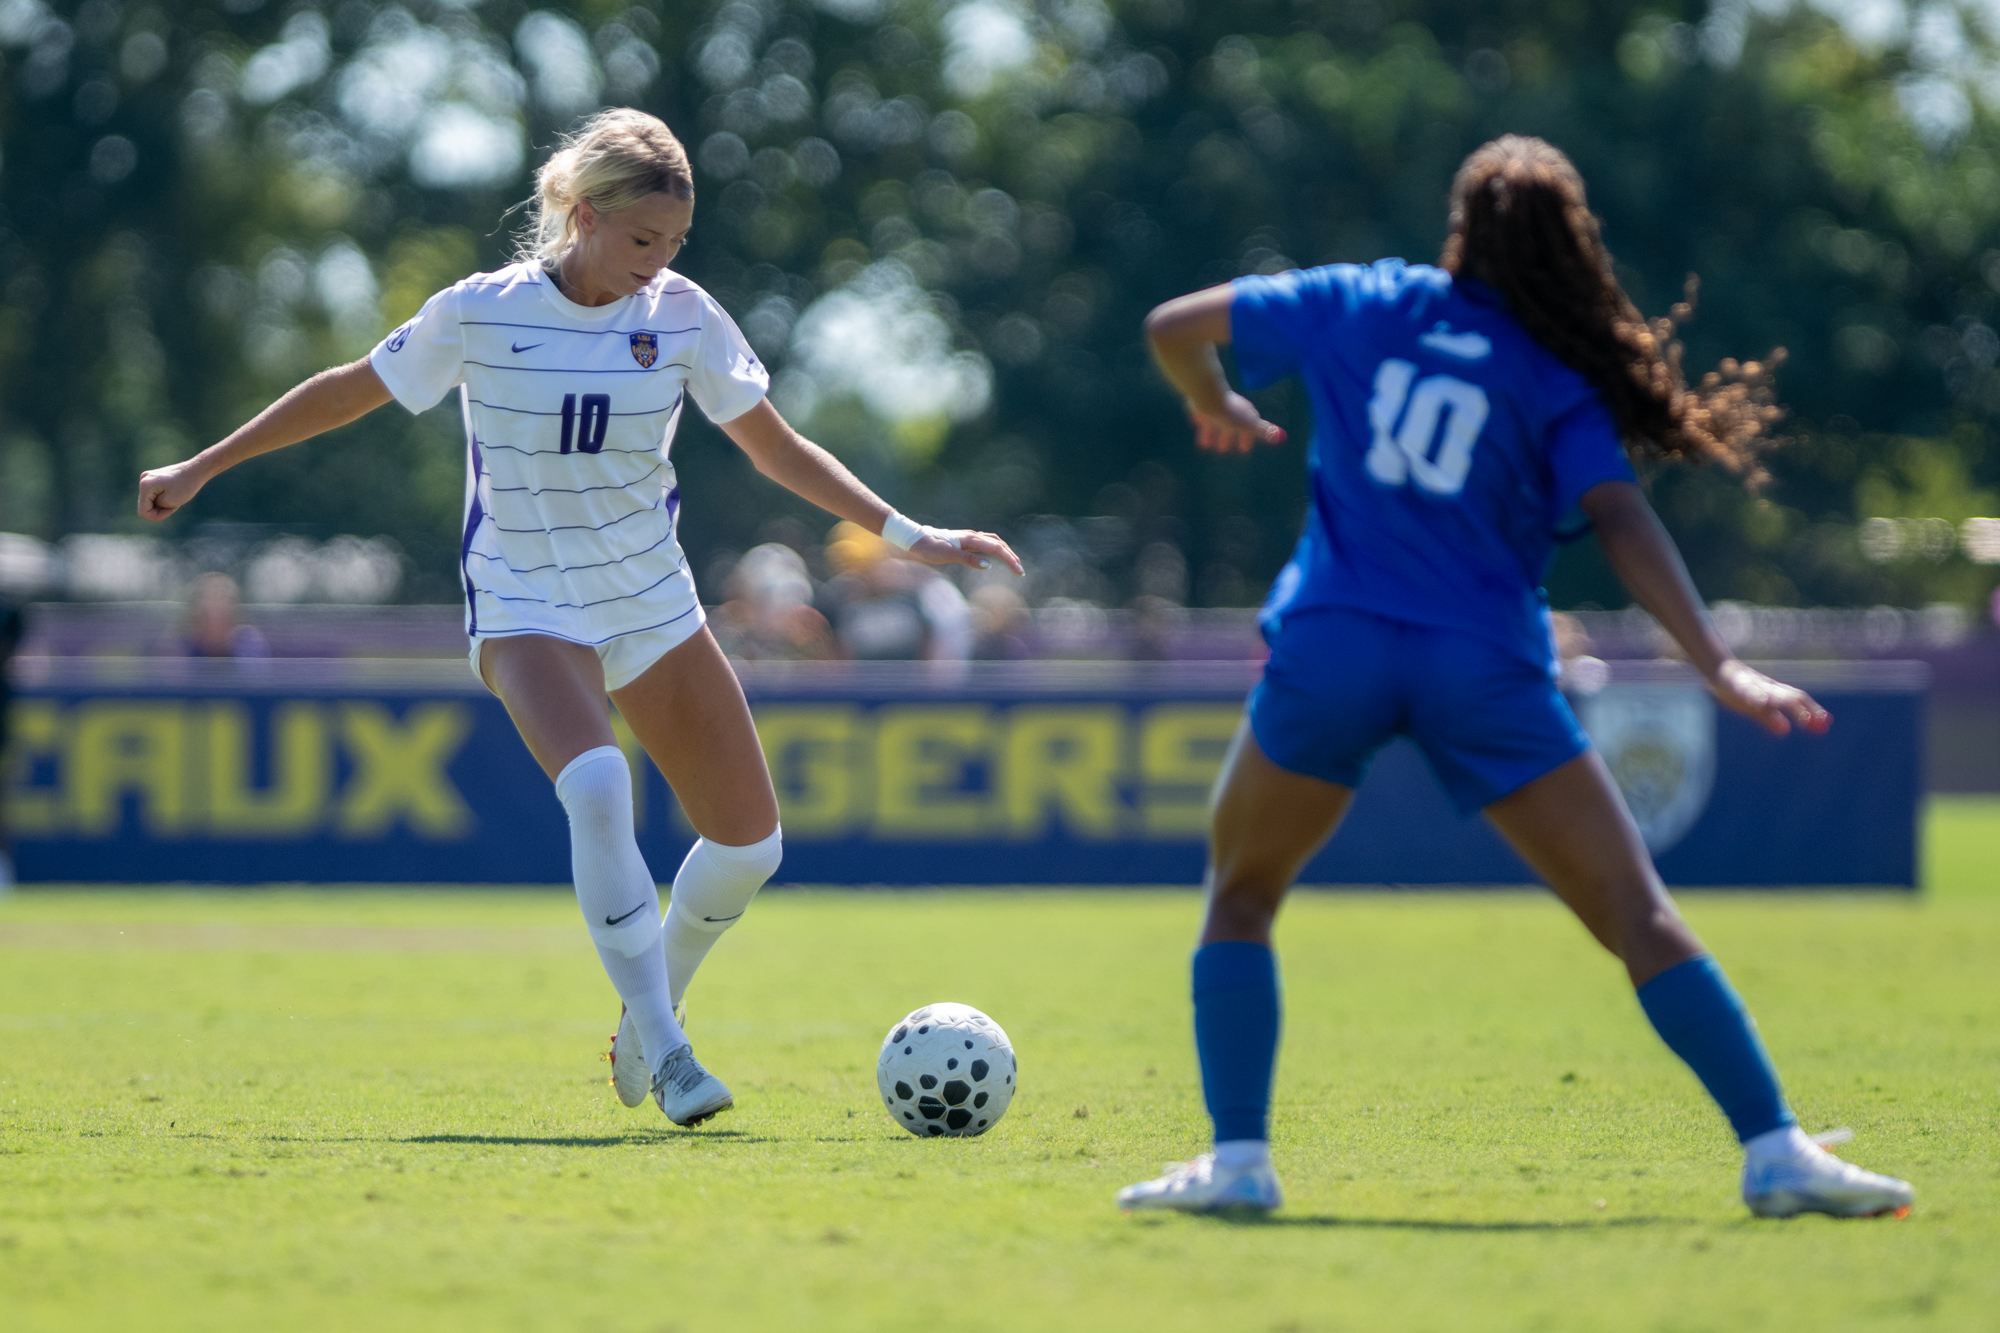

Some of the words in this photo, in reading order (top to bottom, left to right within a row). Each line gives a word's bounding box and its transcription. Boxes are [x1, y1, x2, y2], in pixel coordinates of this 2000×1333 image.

[560, 393, 610, 455] 10
[1365, 356, 1490, 496] 10
[608, 704, 1244, 836] GERS
